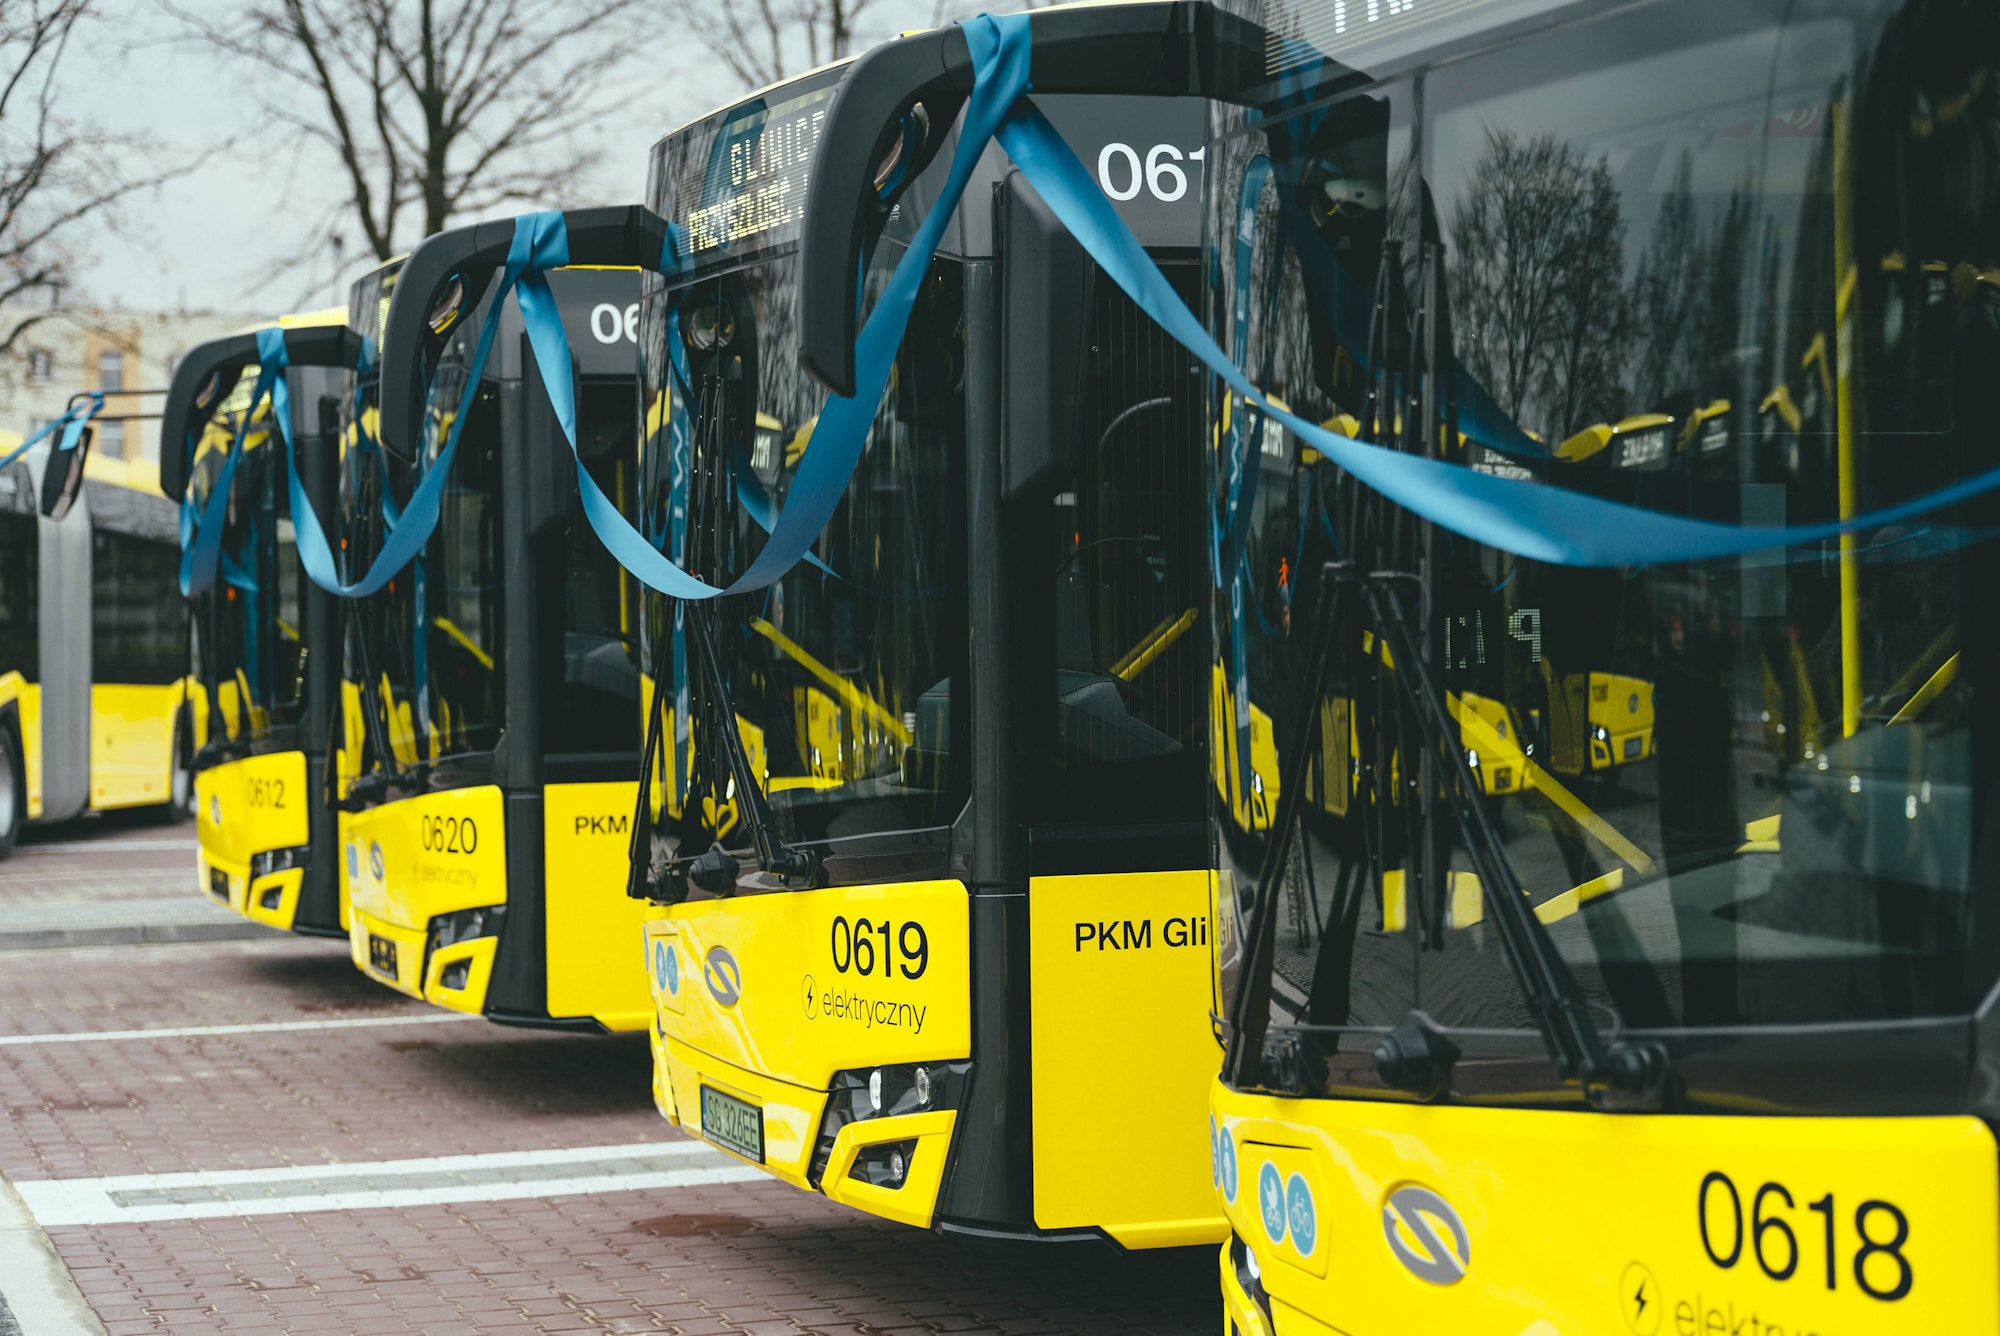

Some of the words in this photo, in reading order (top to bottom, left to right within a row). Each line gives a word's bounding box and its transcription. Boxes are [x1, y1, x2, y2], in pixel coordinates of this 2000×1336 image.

[247, 778, 286, 808] 0612
[422, 814, 477, 854] 0620
[575, 815, 628, 836] PKM
[831, 915, 929, 980] 0619
[1075, 919, 1152, 952] PKM
[1163, 916, 1207, 948] Gli
[822, 986, 927, 1035] elektryczny
[708, 1095, 723, 1133] SG
[724, 1102, 758, 1150] 326EE
[1699, 1170, 1914, 1303] 0618
